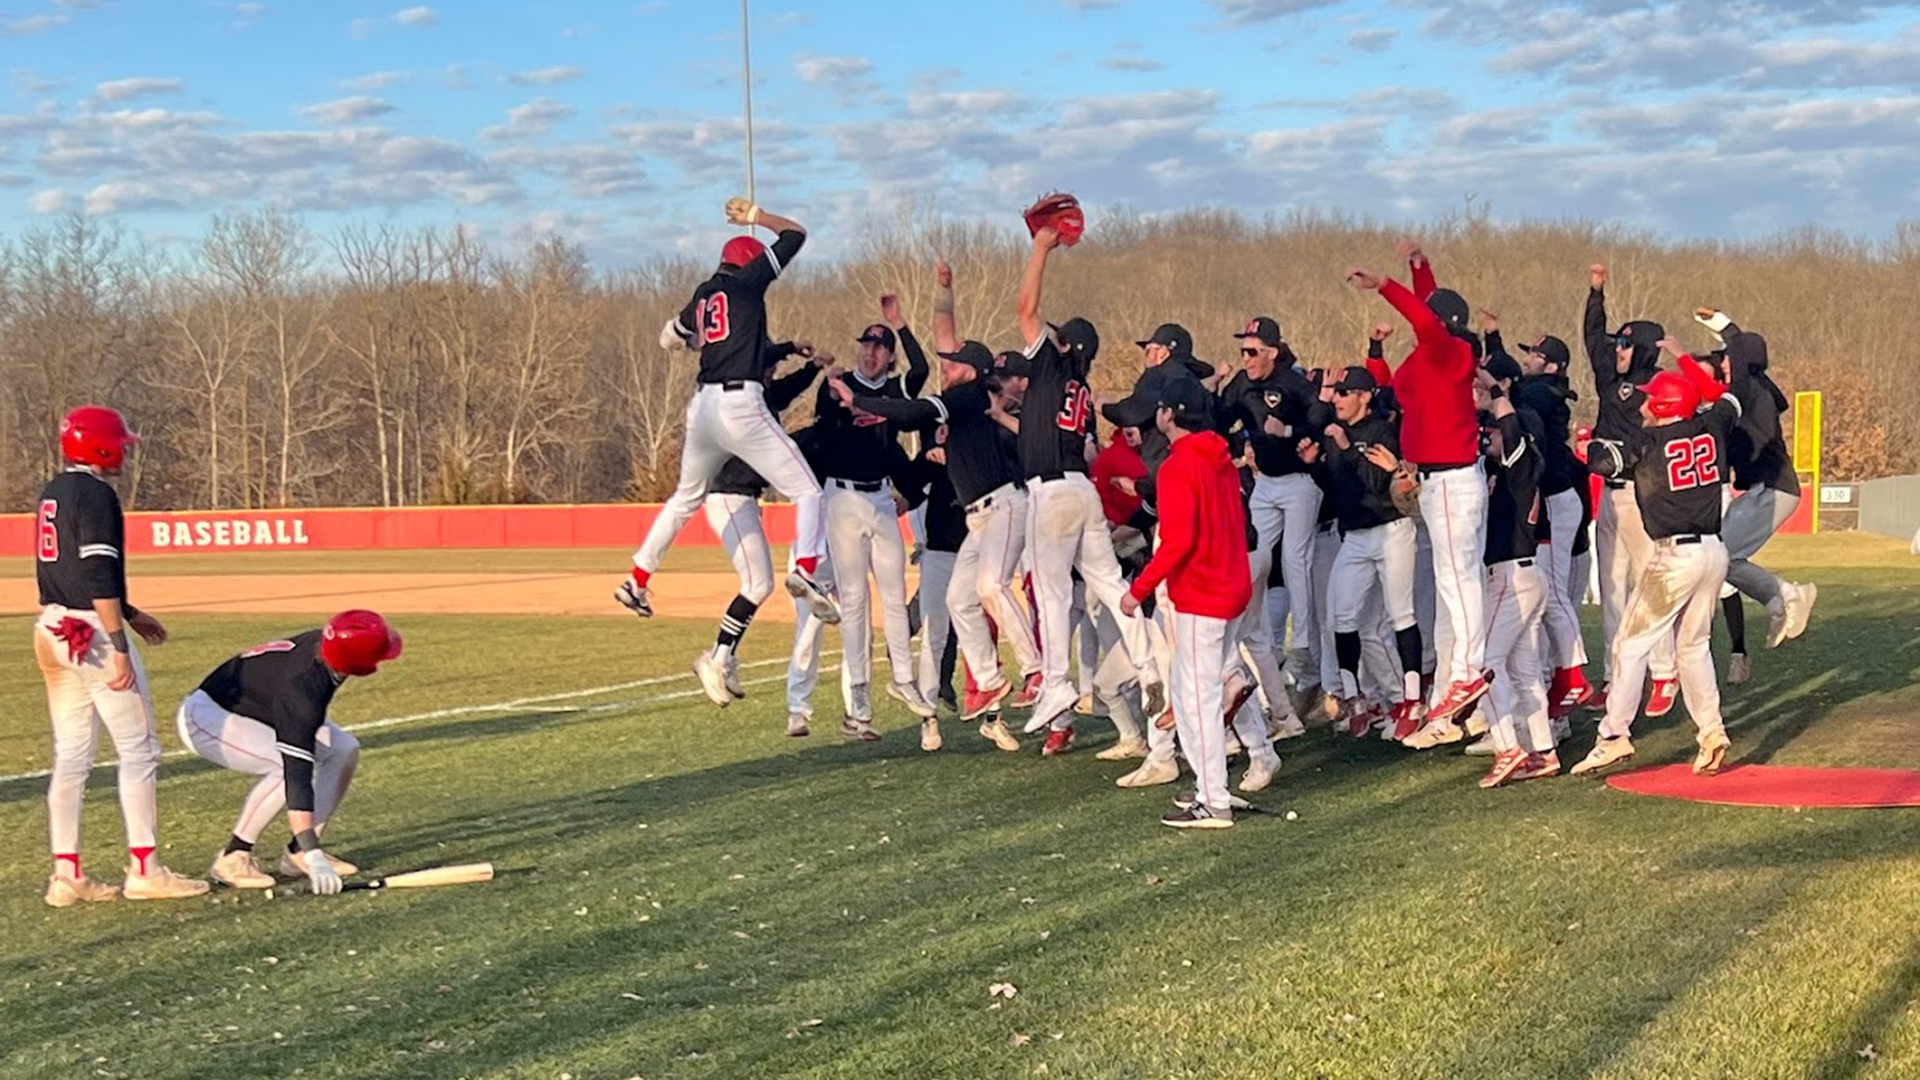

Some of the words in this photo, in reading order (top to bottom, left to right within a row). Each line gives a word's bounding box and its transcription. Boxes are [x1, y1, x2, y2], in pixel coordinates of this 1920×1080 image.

[1663, 433, 1720, 492] 22
[1826, 489, 1845, 501] 330
[38, 498, 60, 563] 6
[151, 519, 309, 547] BASEBALL
